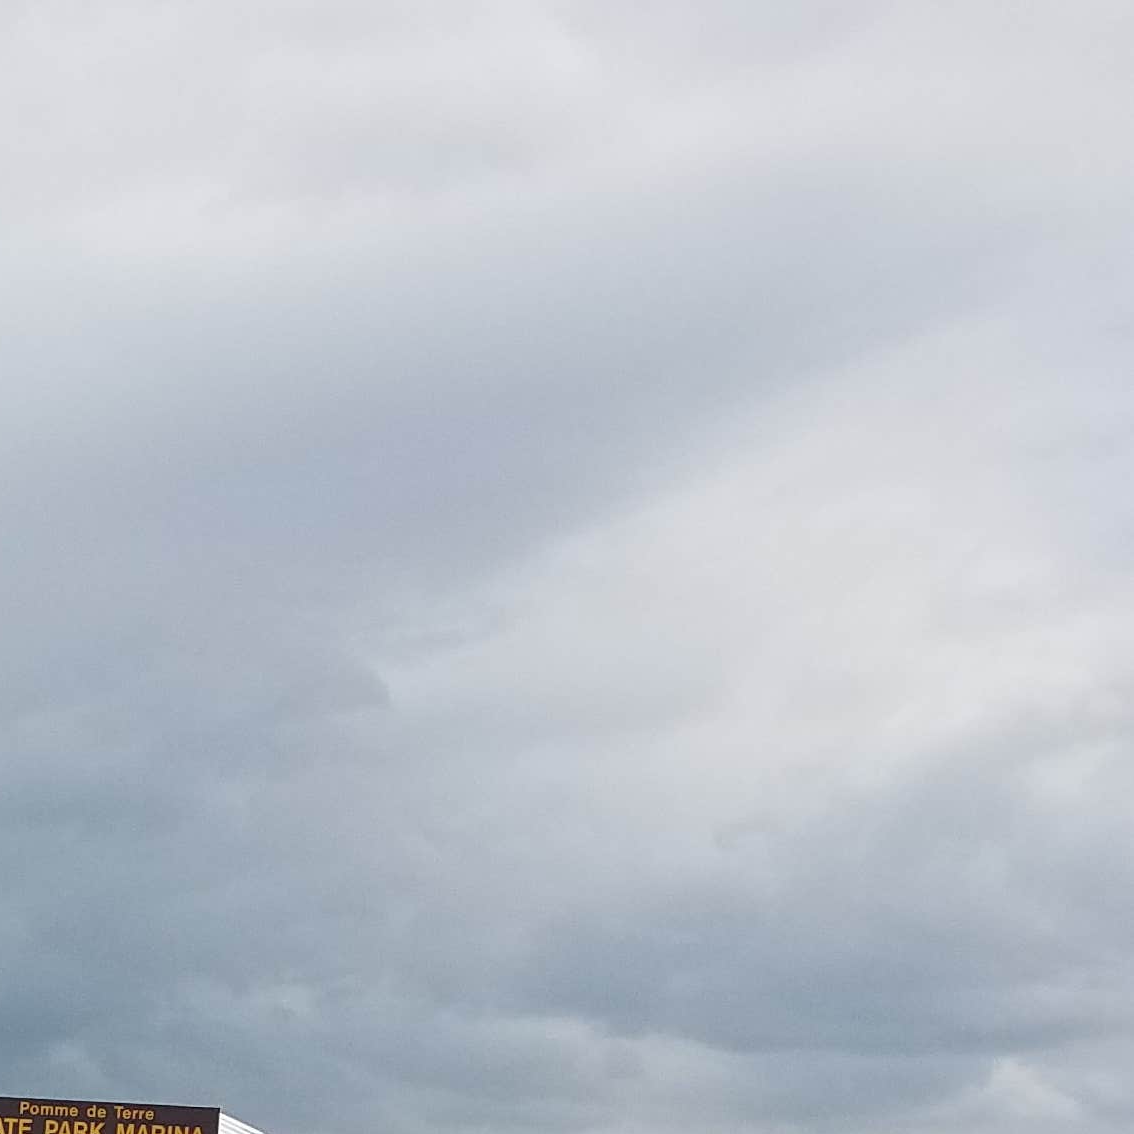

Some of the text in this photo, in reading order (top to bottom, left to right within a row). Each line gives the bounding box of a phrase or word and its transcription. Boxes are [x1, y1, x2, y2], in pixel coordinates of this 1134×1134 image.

[19, 1101, 155, 1120] Pomme de Terre
